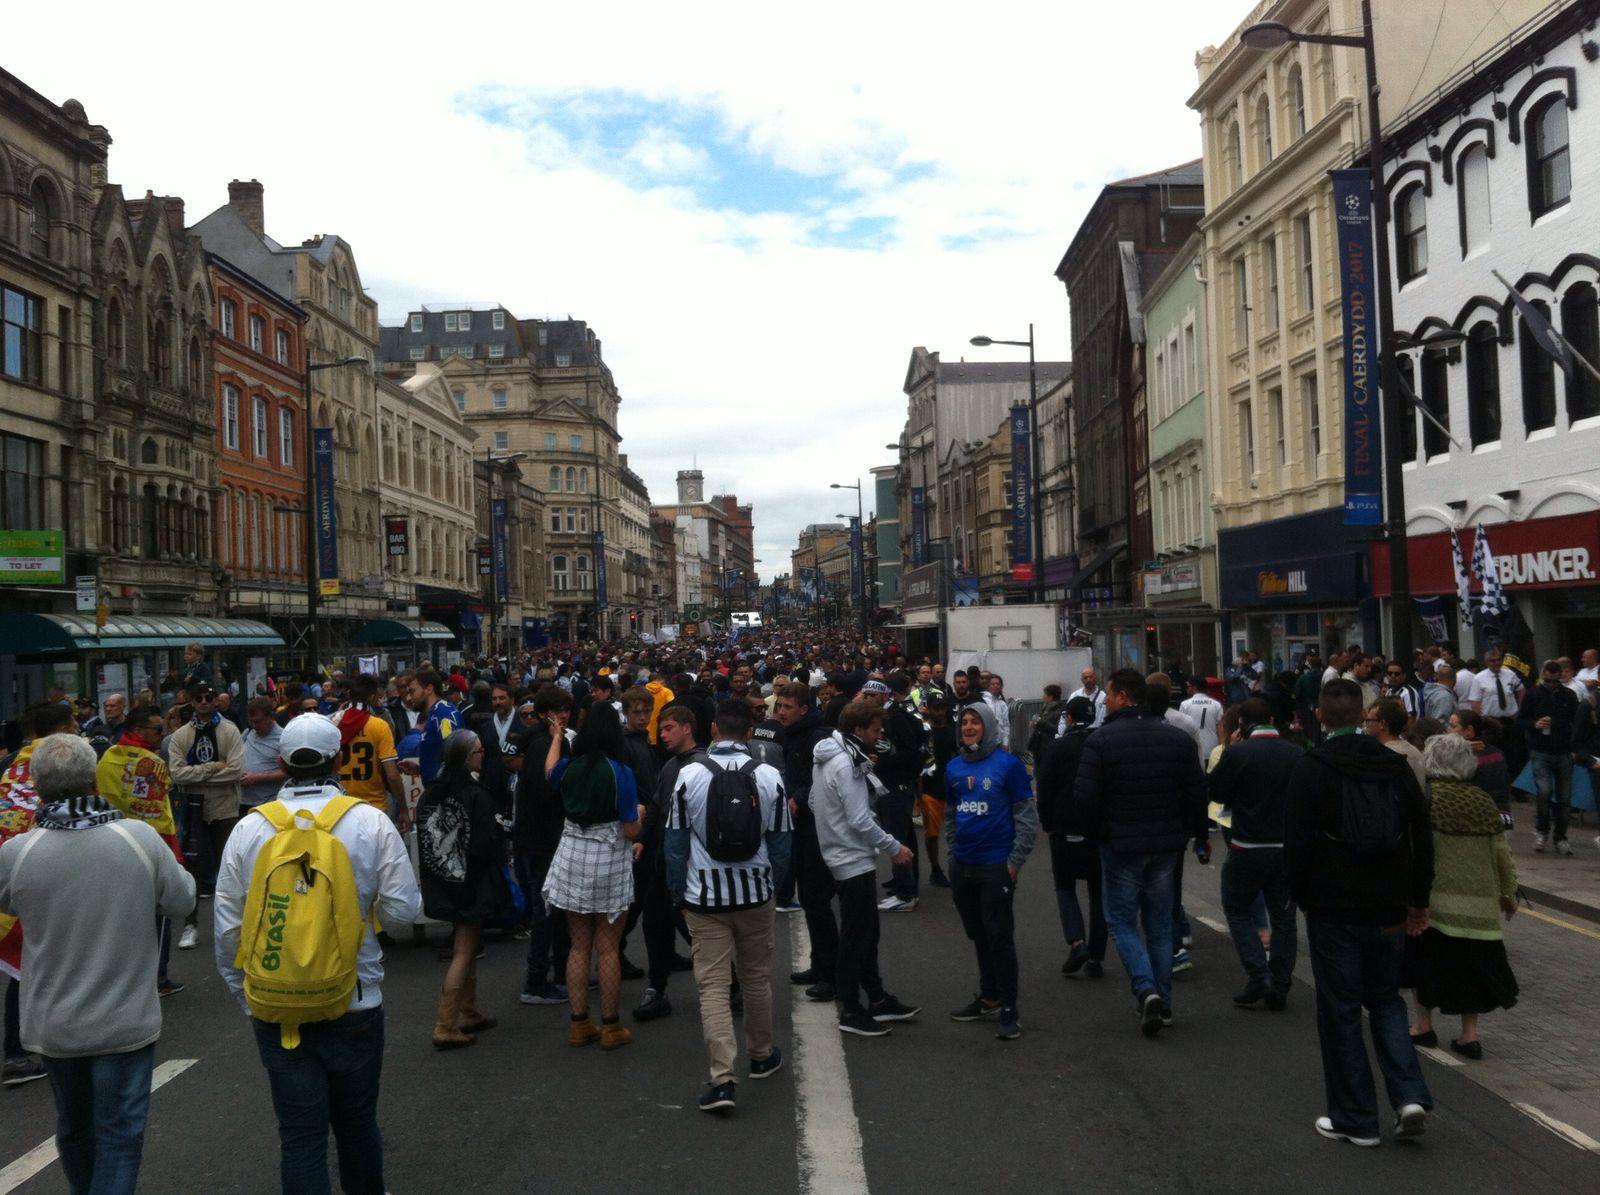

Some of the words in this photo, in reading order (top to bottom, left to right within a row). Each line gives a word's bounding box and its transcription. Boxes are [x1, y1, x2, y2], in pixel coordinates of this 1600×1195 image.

[1348, 239, 1366, 284] 2017
[1350, 290, 1369, 406] CAERDYDD
[1354, 413, 1370, 476] FINAL
[389, 534, 405, 543] BAR
[9, 562, 22, 570] TO
[25, 562, 43, 570] LET
[1288, 570, 1308, 593] HILL
[754, 728, 776, 739] BUFFON
[957, 799, 989, 815] Jeep
